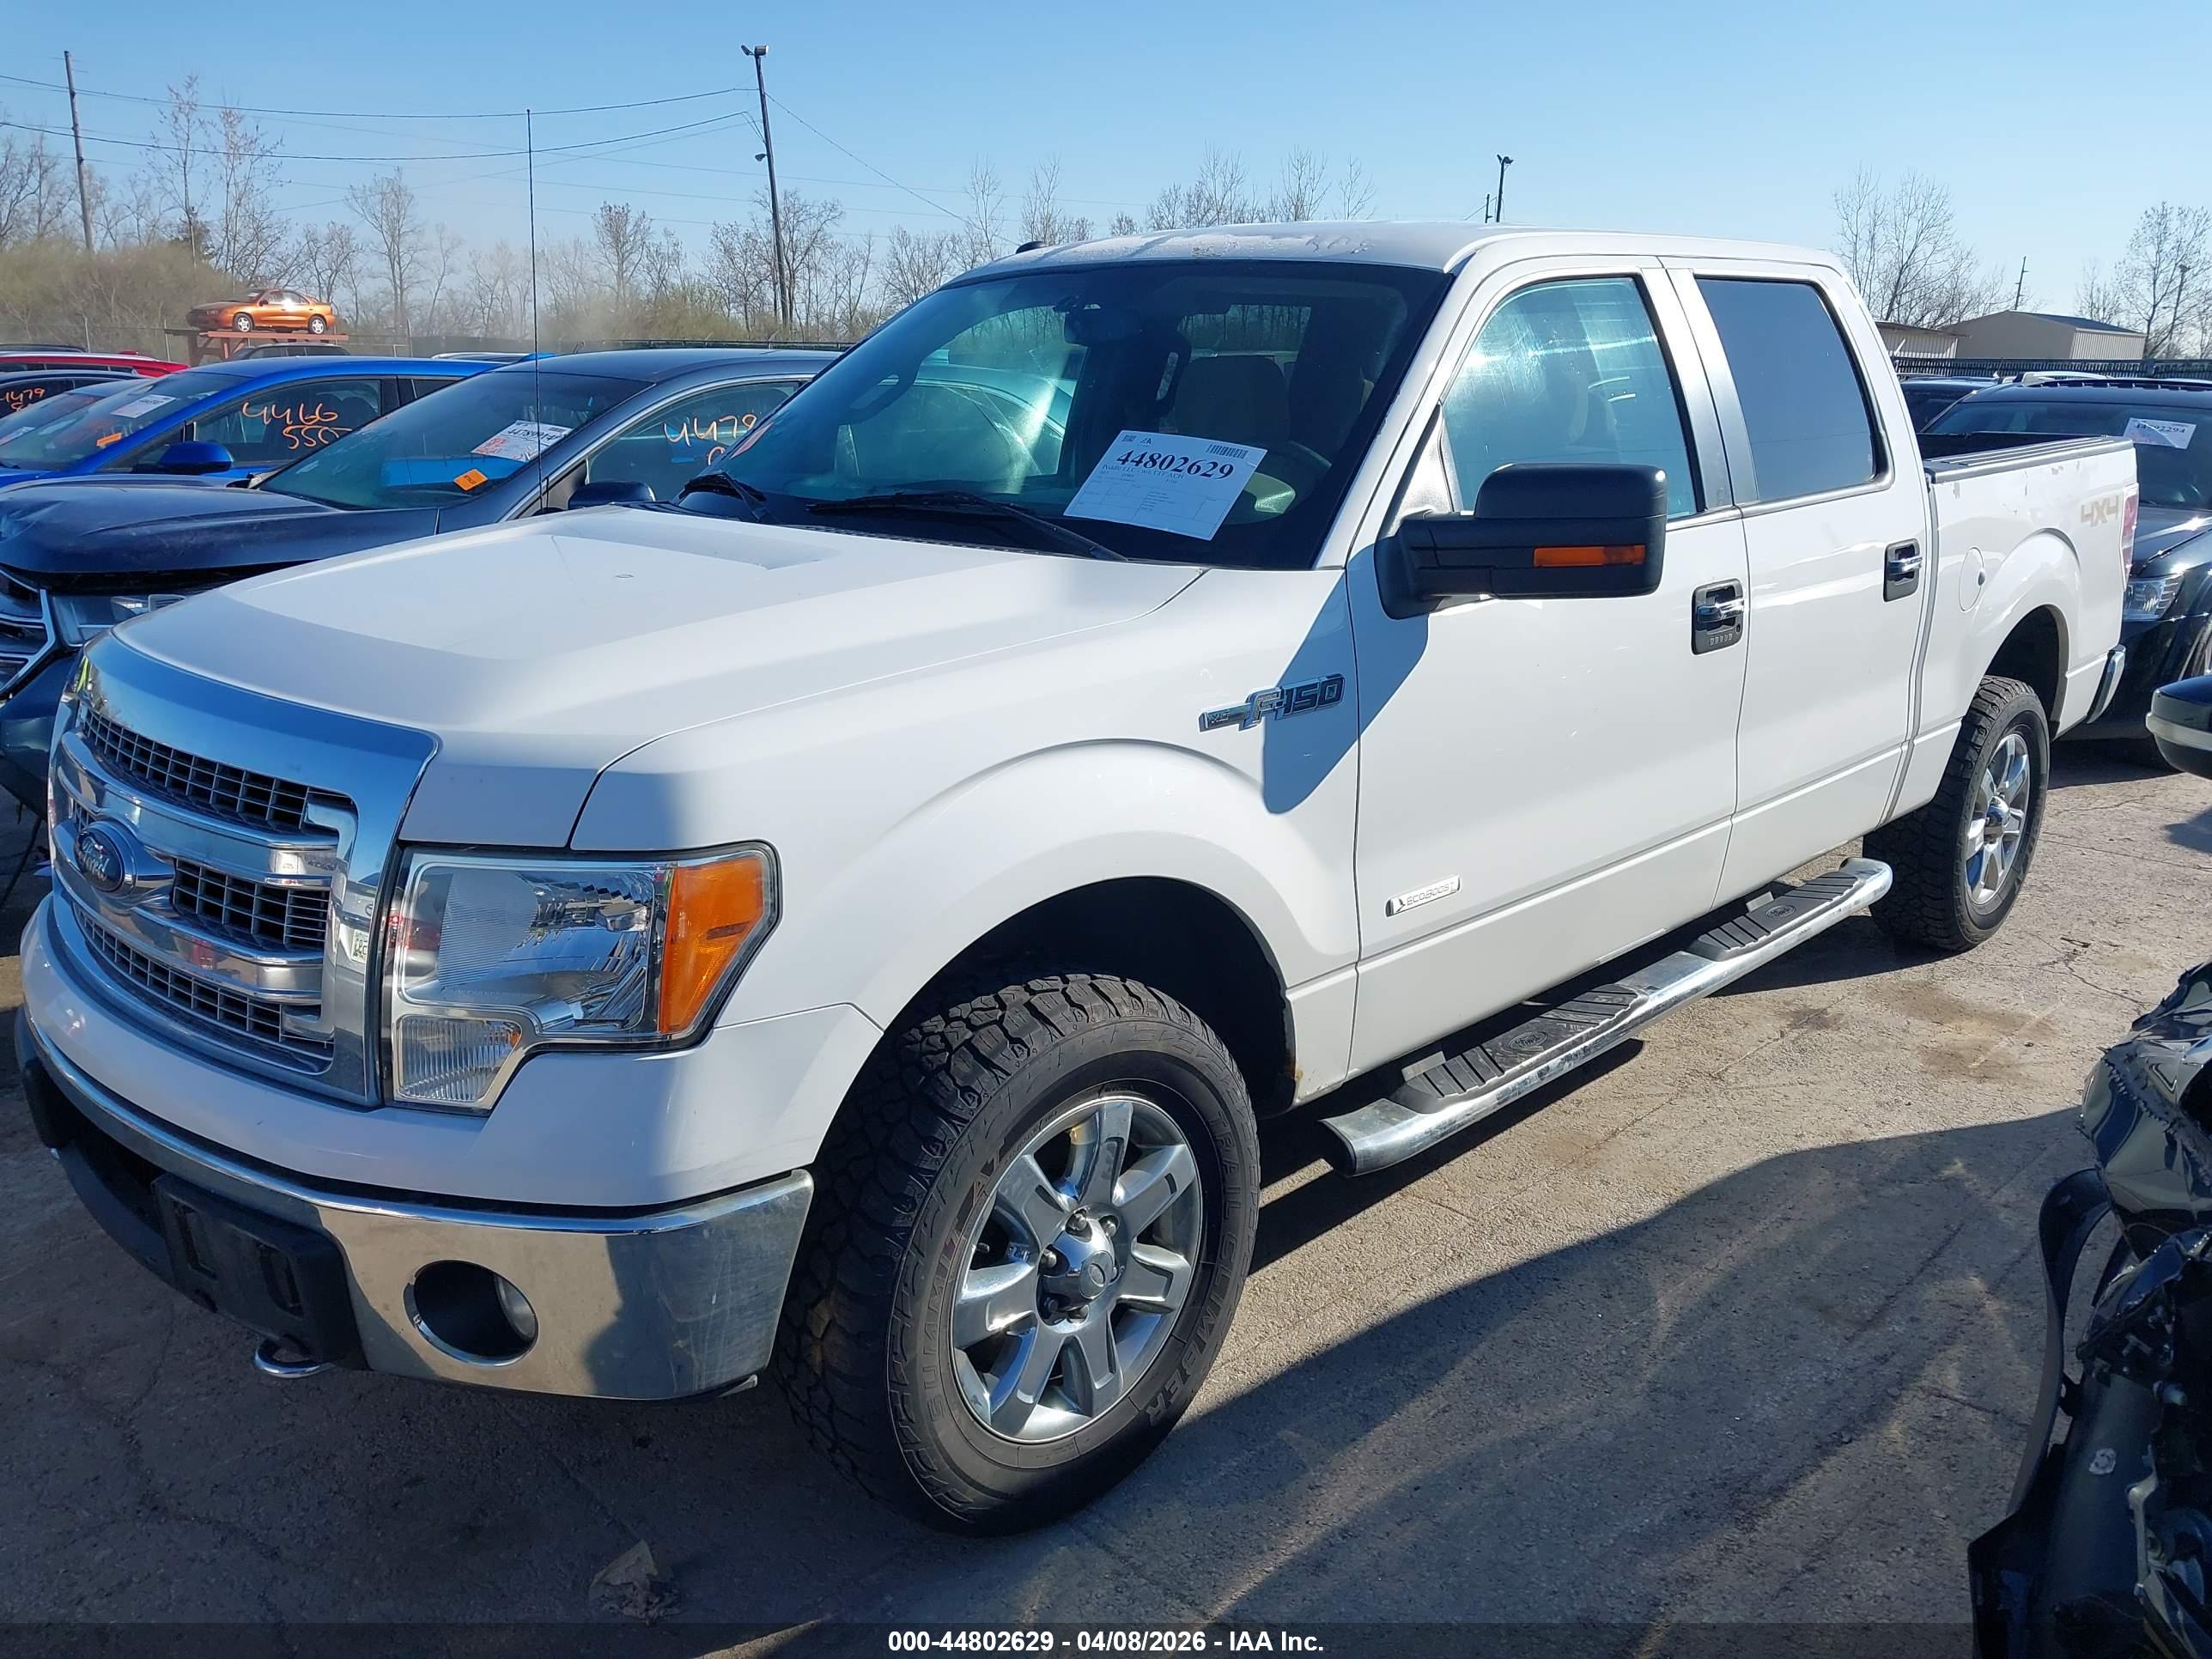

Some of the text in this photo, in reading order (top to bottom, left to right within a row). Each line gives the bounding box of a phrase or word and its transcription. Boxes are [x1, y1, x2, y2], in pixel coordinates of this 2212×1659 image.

[1115, 449, 1235, 482] 44802629
[1239, 674, 1346, 731] F-150
[78, 835, 111, 882] Ford
